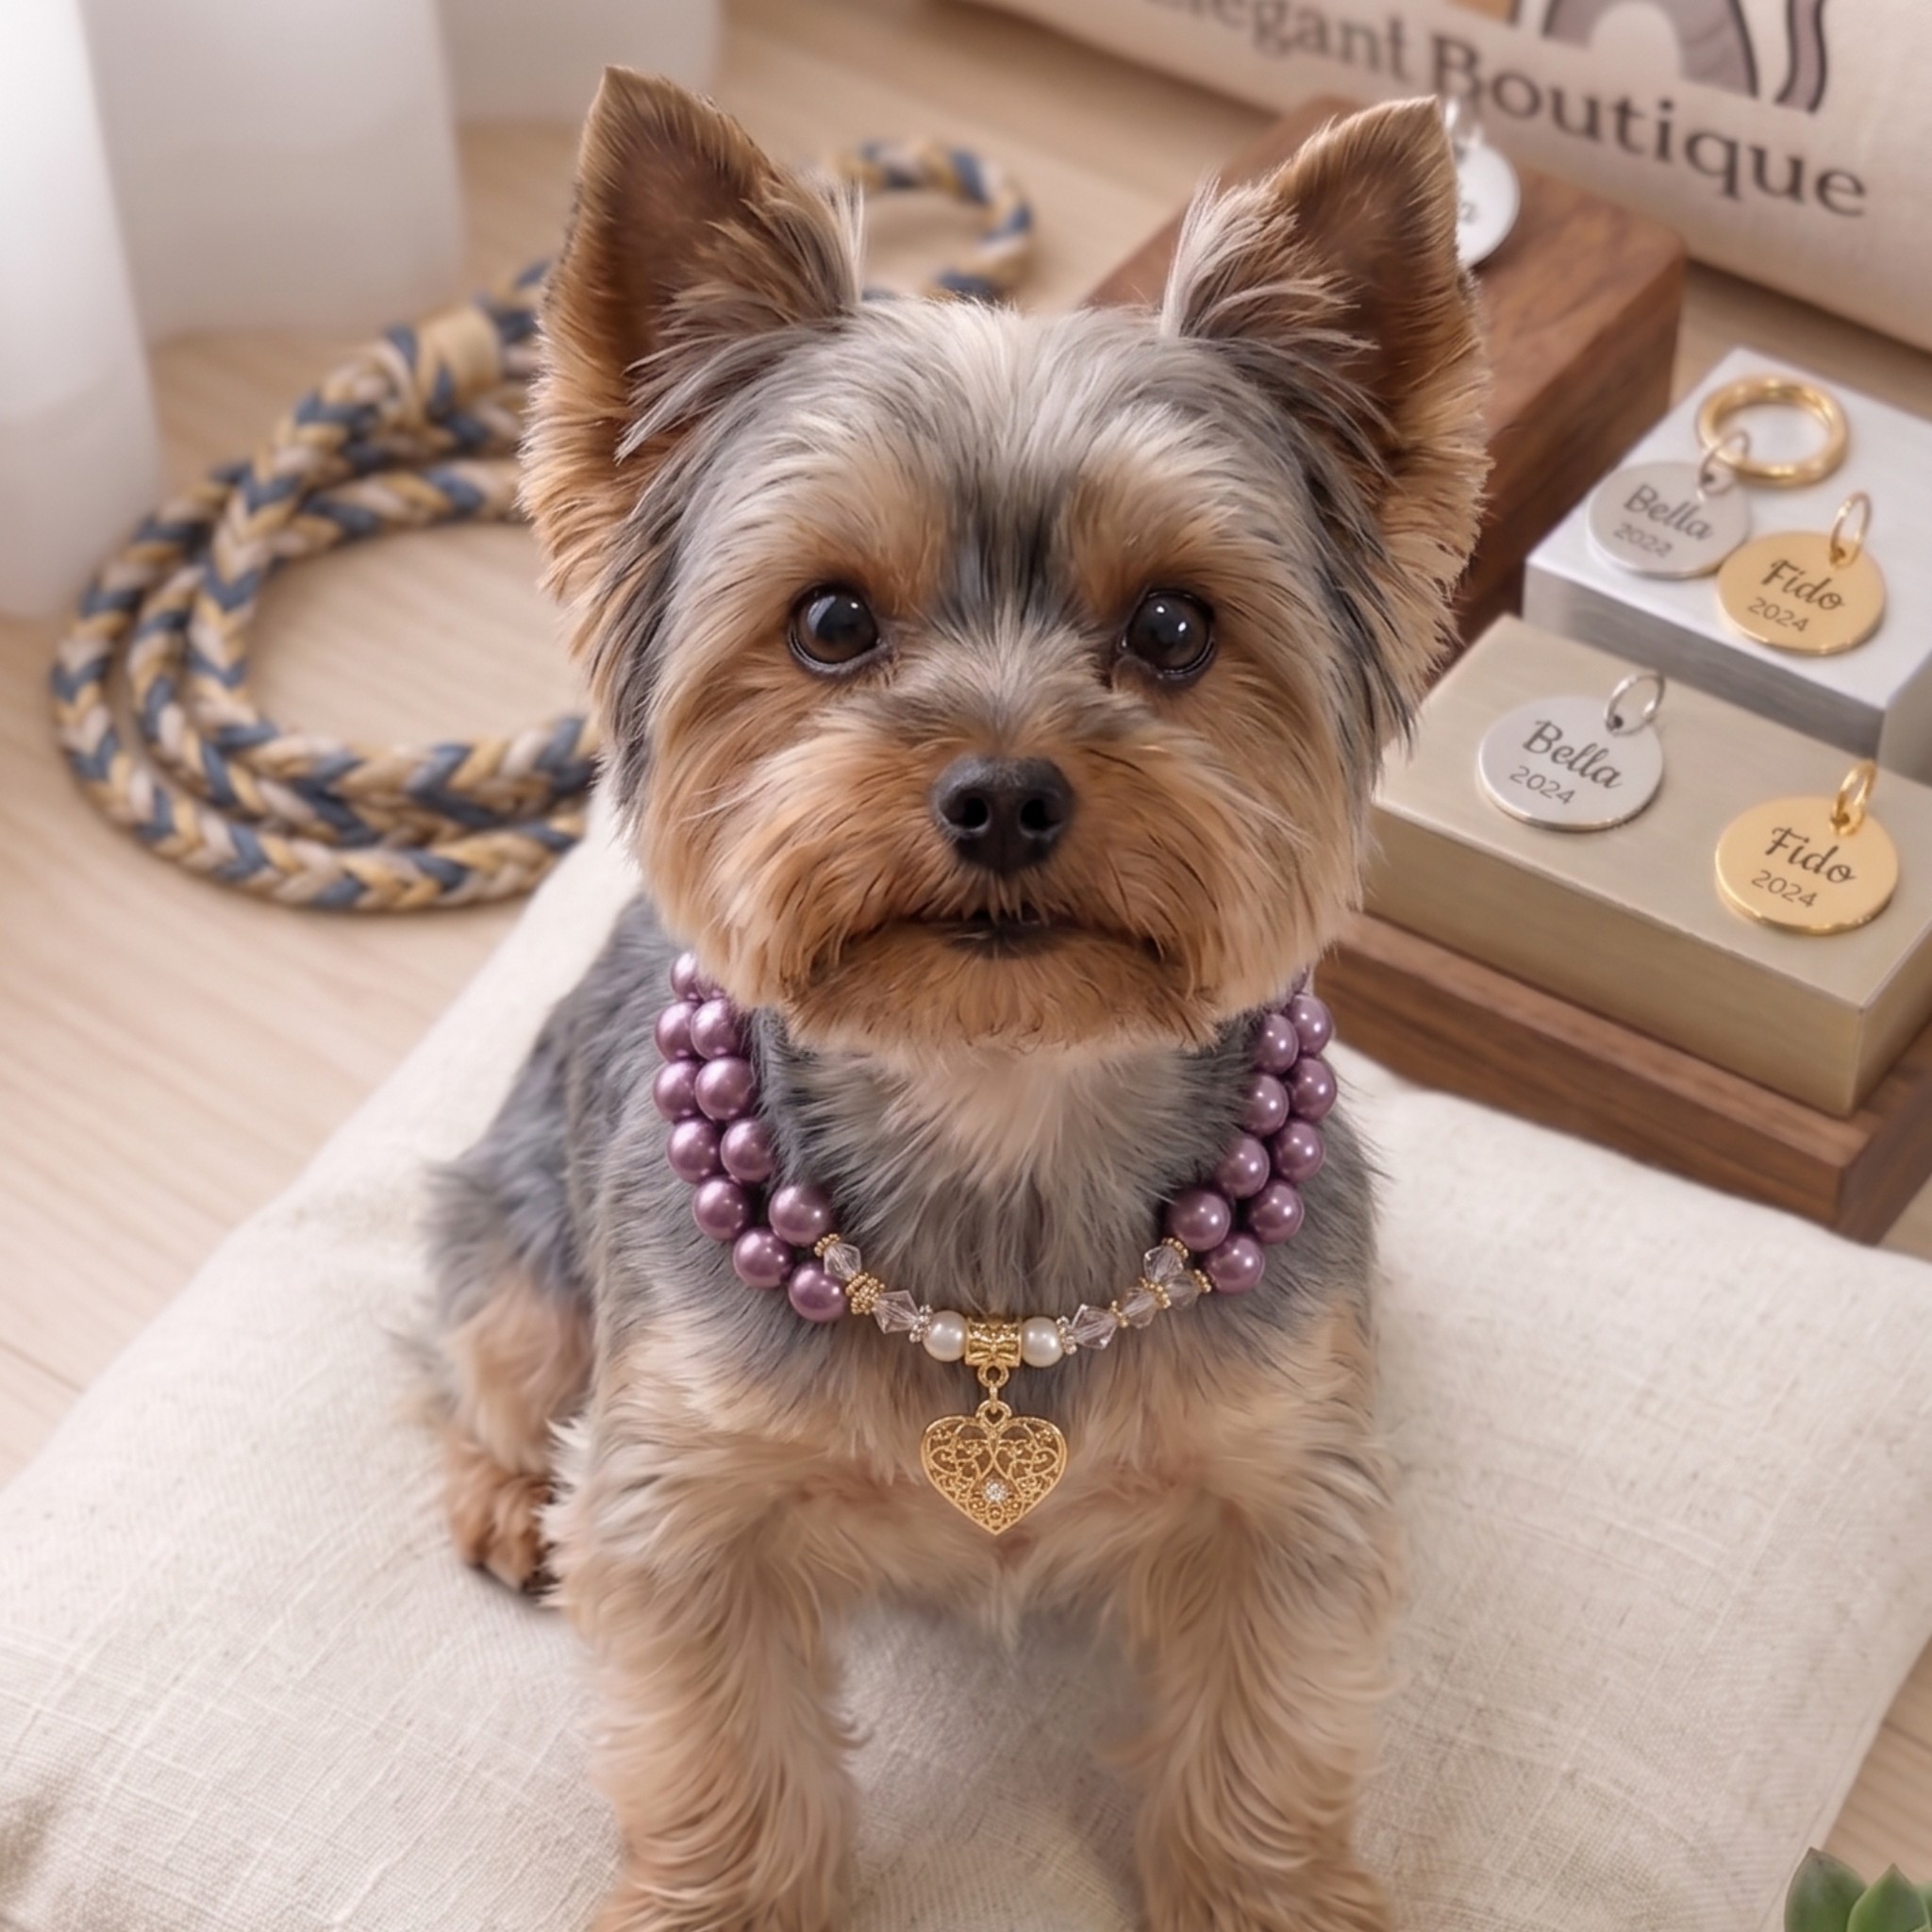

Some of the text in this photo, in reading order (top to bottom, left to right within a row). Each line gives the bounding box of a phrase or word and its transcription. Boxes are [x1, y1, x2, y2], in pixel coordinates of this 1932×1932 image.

[1141, 0, 1867, 217] egant Boutique
[1624, 482, 1714, 541] Bella
[1761, 559, 1845, 611] Fido
[1747, 597, 1809, 633] 2024
[1523, 720, 1622, 789] Bella
[1509, 765, 1575, 805] 2024
[1765, 826, 1857, 885] Fido
[1751, 870, 1817, 908] 2024
